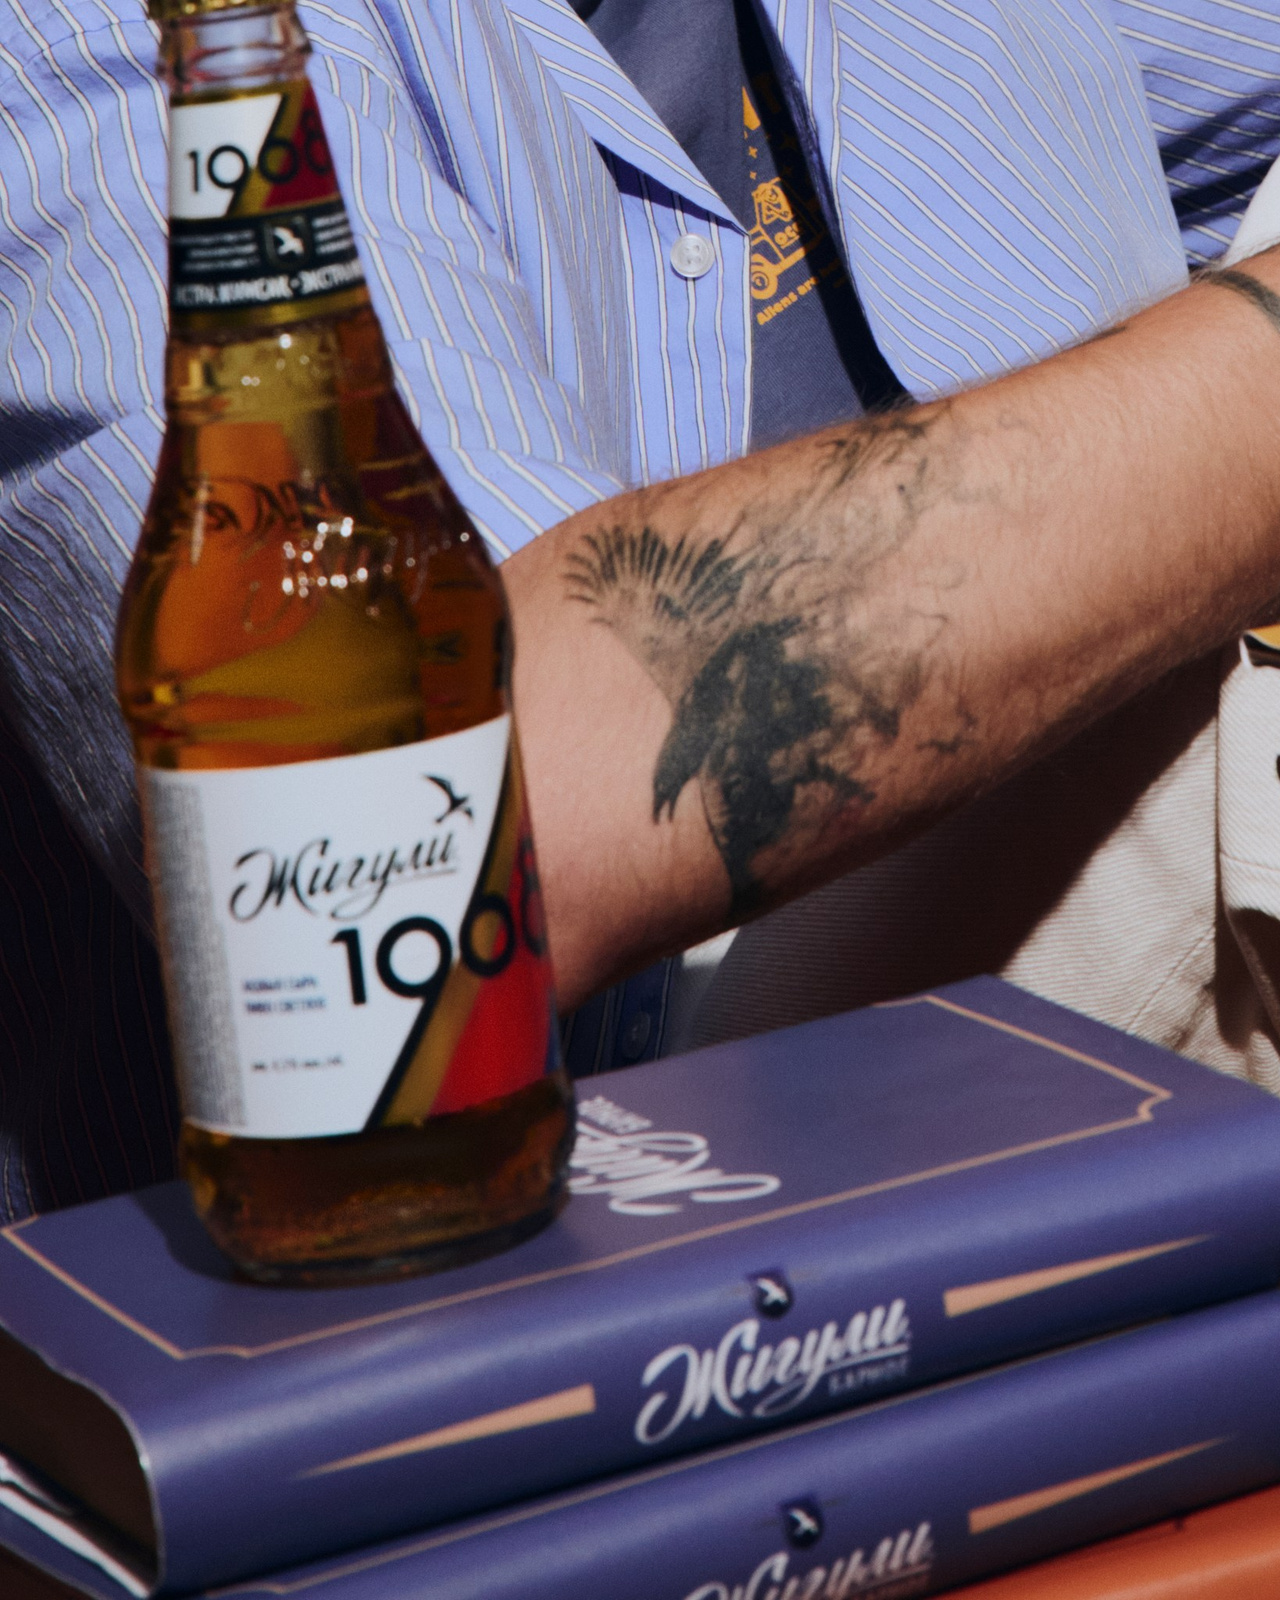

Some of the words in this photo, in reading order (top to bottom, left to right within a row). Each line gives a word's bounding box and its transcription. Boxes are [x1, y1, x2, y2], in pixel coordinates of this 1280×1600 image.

[756, 291, 799, 326] Aliens
[229, 832, 458, 923] Жигули
[633, 1298, 909, 1444] Жигули
